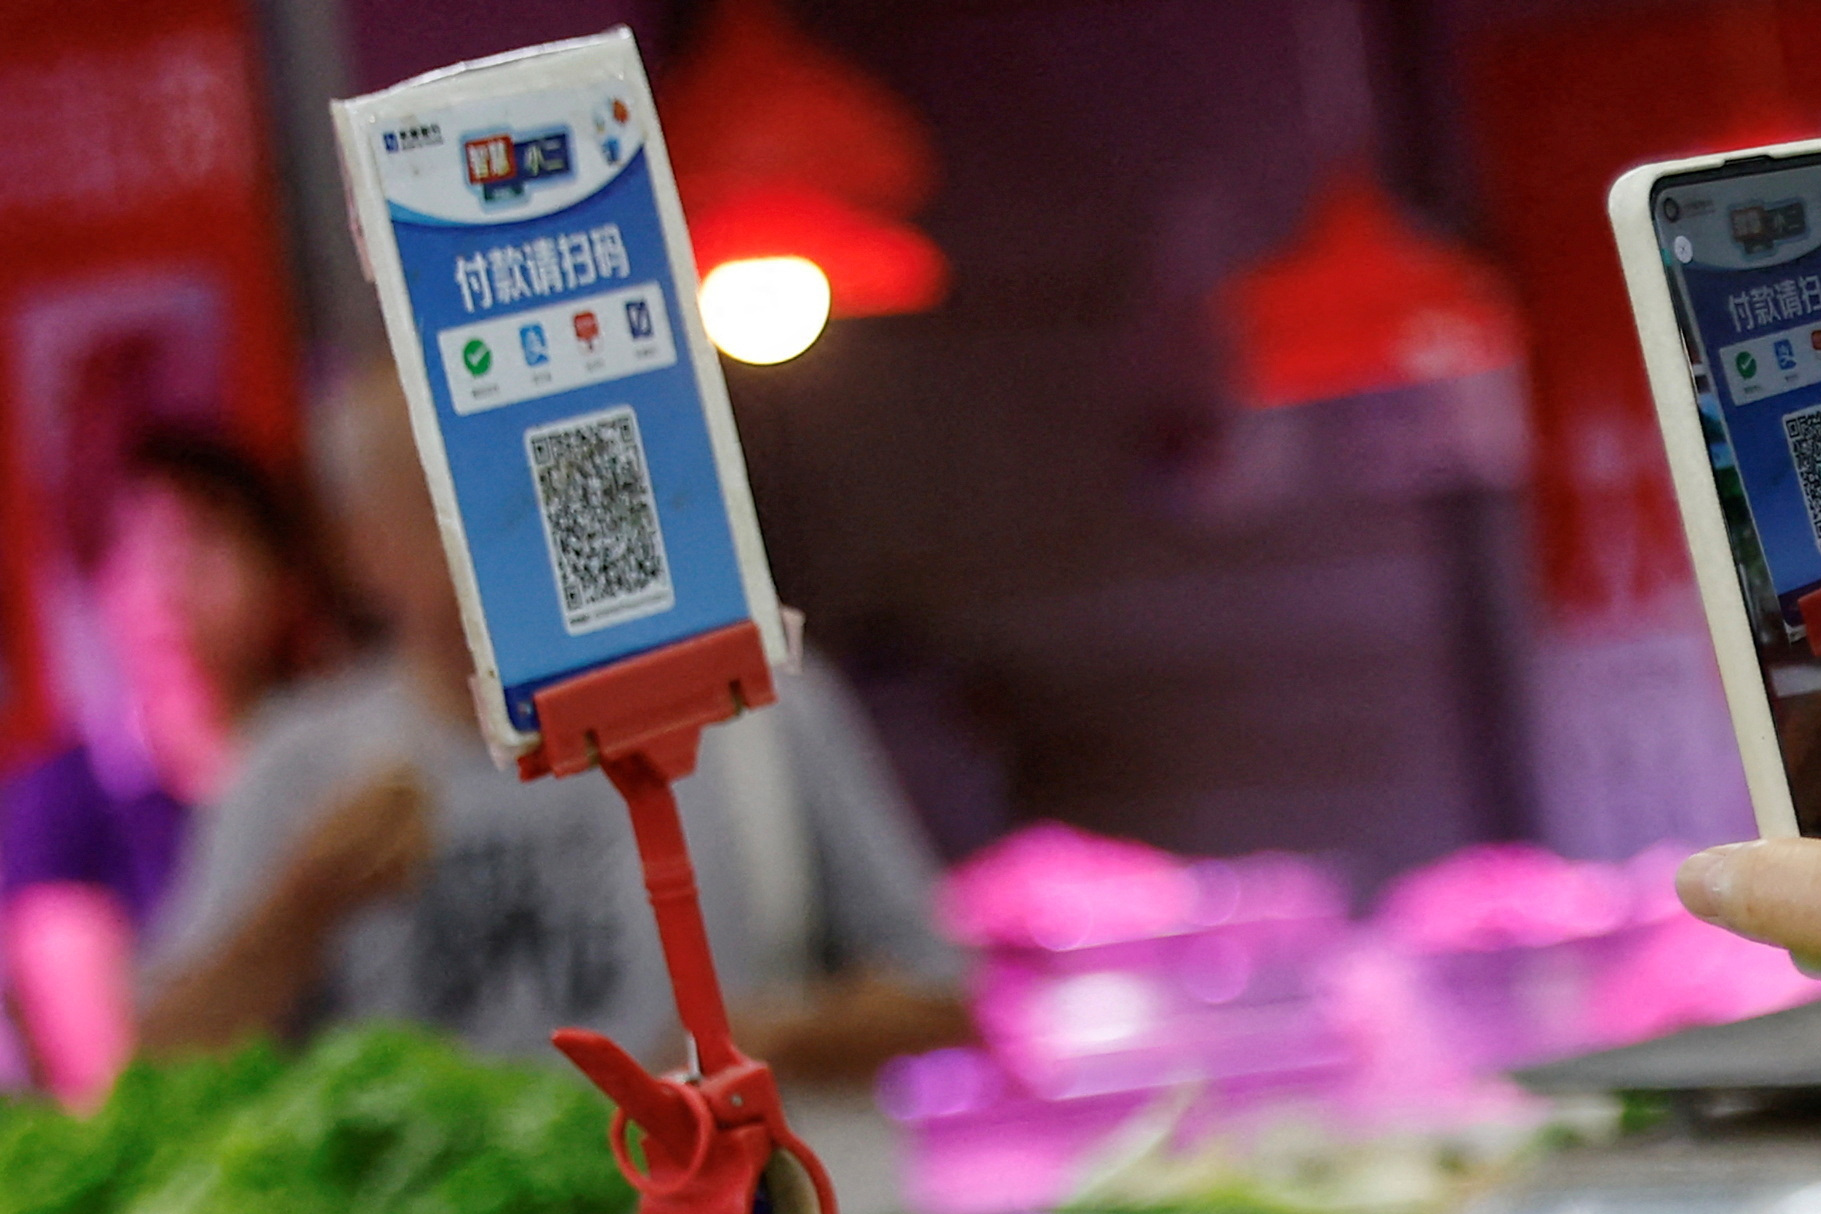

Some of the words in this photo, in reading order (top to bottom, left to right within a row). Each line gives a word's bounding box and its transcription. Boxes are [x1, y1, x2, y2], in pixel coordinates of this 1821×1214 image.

[455, 223, 631, 313] 付款请扫码
